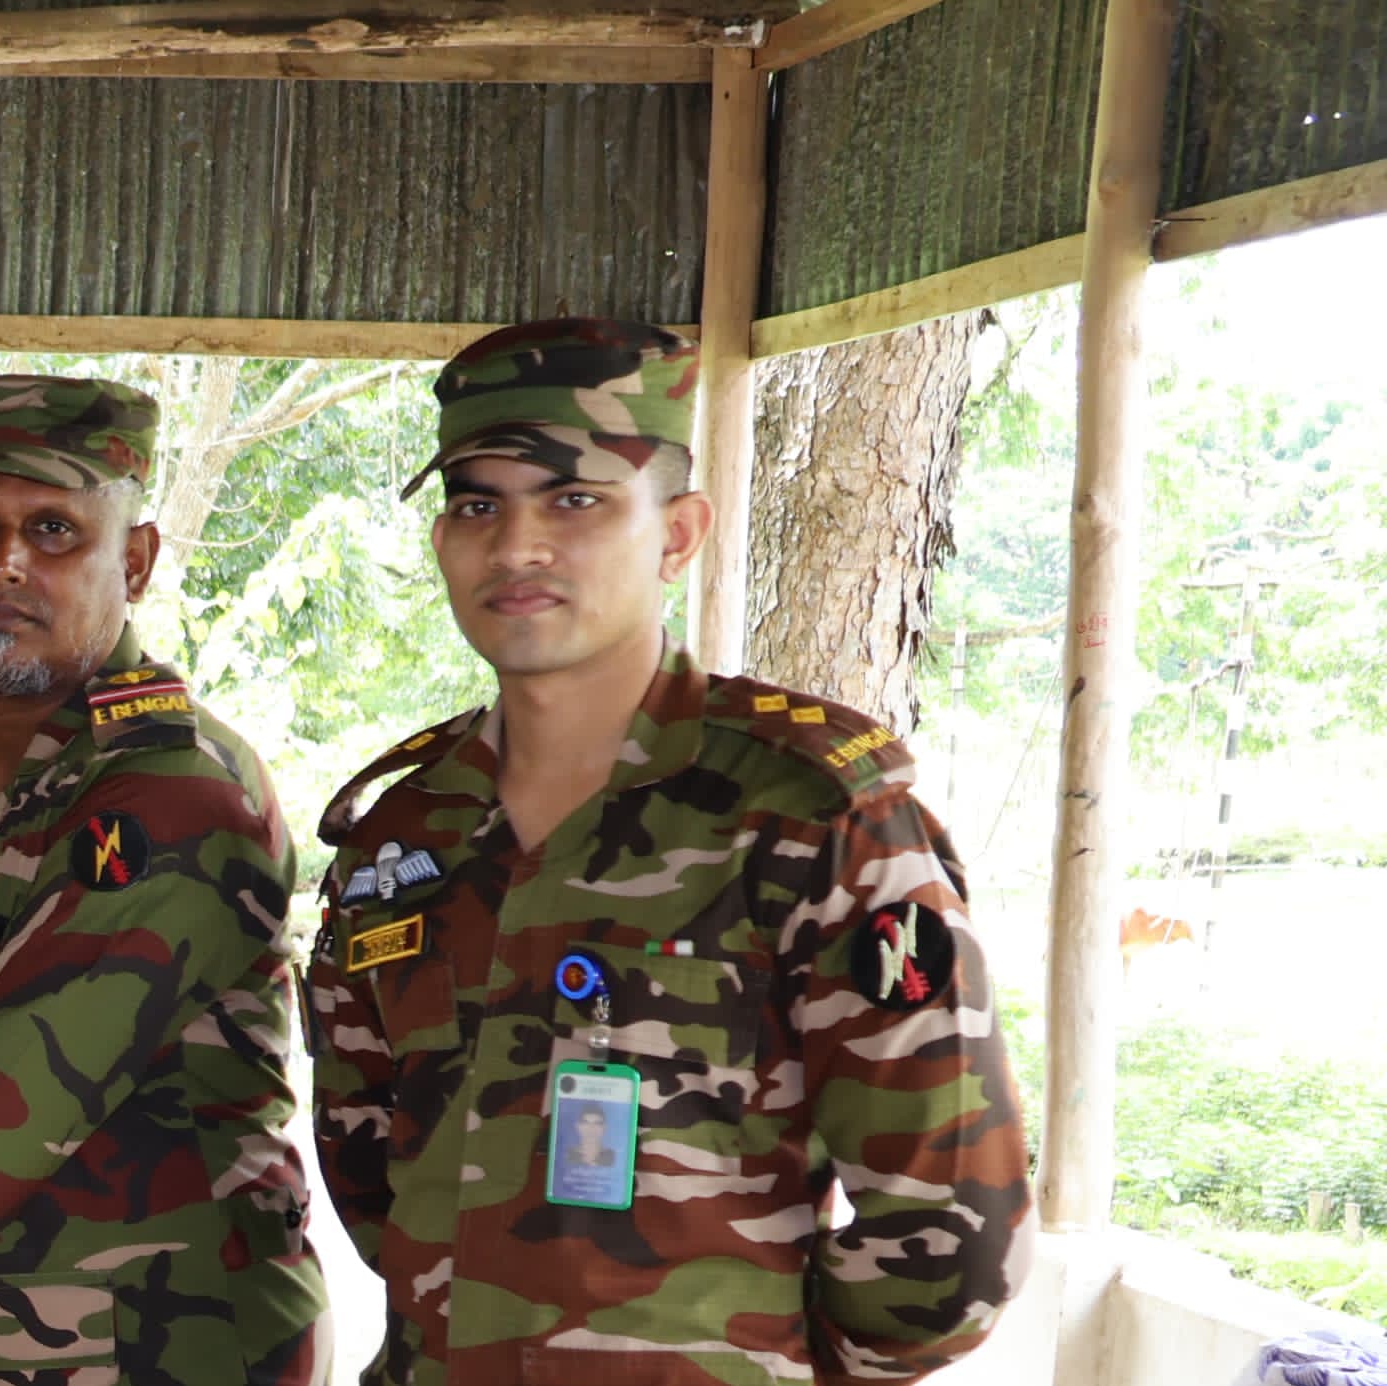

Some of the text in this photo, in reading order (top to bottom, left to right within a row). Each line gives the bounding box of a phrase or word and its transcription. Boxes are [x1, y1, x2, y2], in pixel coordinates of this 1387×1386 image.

[92, 694, 196, 726] E BENGAL
[824, 725, 899, 769] E BENGAL
